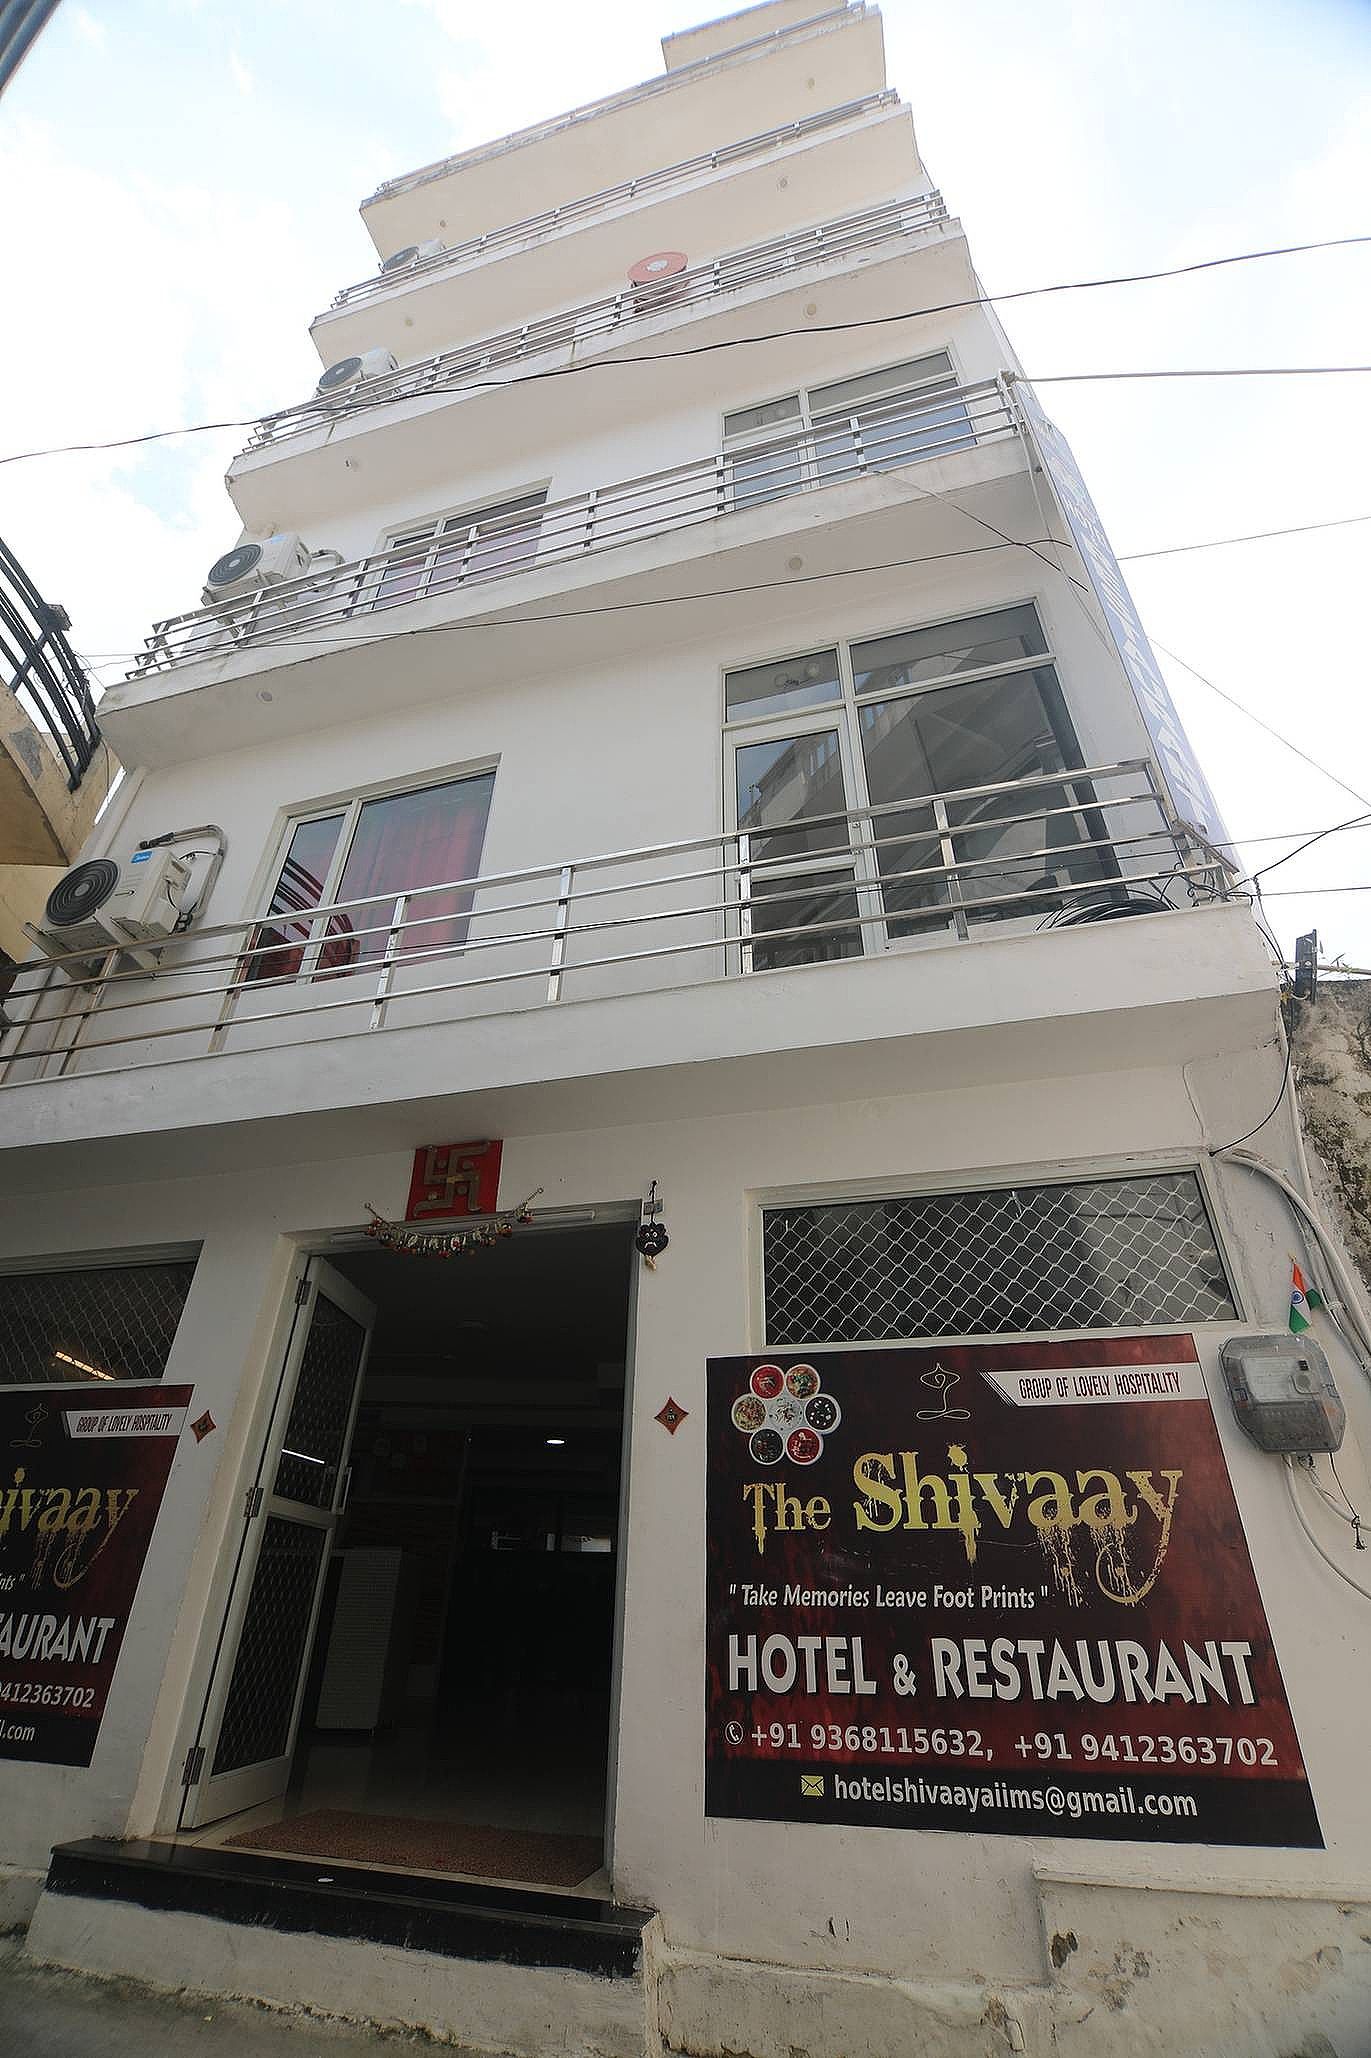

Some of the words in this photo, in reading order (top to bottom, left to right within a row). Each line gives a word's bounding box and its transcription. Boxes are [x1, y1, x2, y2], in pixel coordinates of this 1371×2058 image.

[1019, 1378, 1052, 1399] GROUP
[1056, 1377, 1069, 1398] OF
[1073, 1375, 1110, 1397] LOVELY
[1116, 1371, 1181, 1395] HOSPITALITY
[0, 1467, 139, 1589] ivaay
[743, 1483, 832, 1554] The
[852, 1443, 1184, 1605] Shivaay
[783, 1584, 869, 1607] Memories
[876, 1584, 926, 1607] Leave
[933, 1584, 975, 1608] Foot
[728, 1633, 877, 1695] HOTEL
[894, 1653, 917, 1697] &
[931, 1637, 1254, 1704] RESTAURANT
[0, 1682, 95, 1708] 412363702
[752, 1722, 801, 1748] +91
[811, 1724, 993, 1761] 9368115632,
[1015, 1733, 1072, 1760] +91
[1081, 1734, 1278, 1766] 9412363702
[835, 1774, 1198, 1817] hotelshivaayaiims@gmail.com
